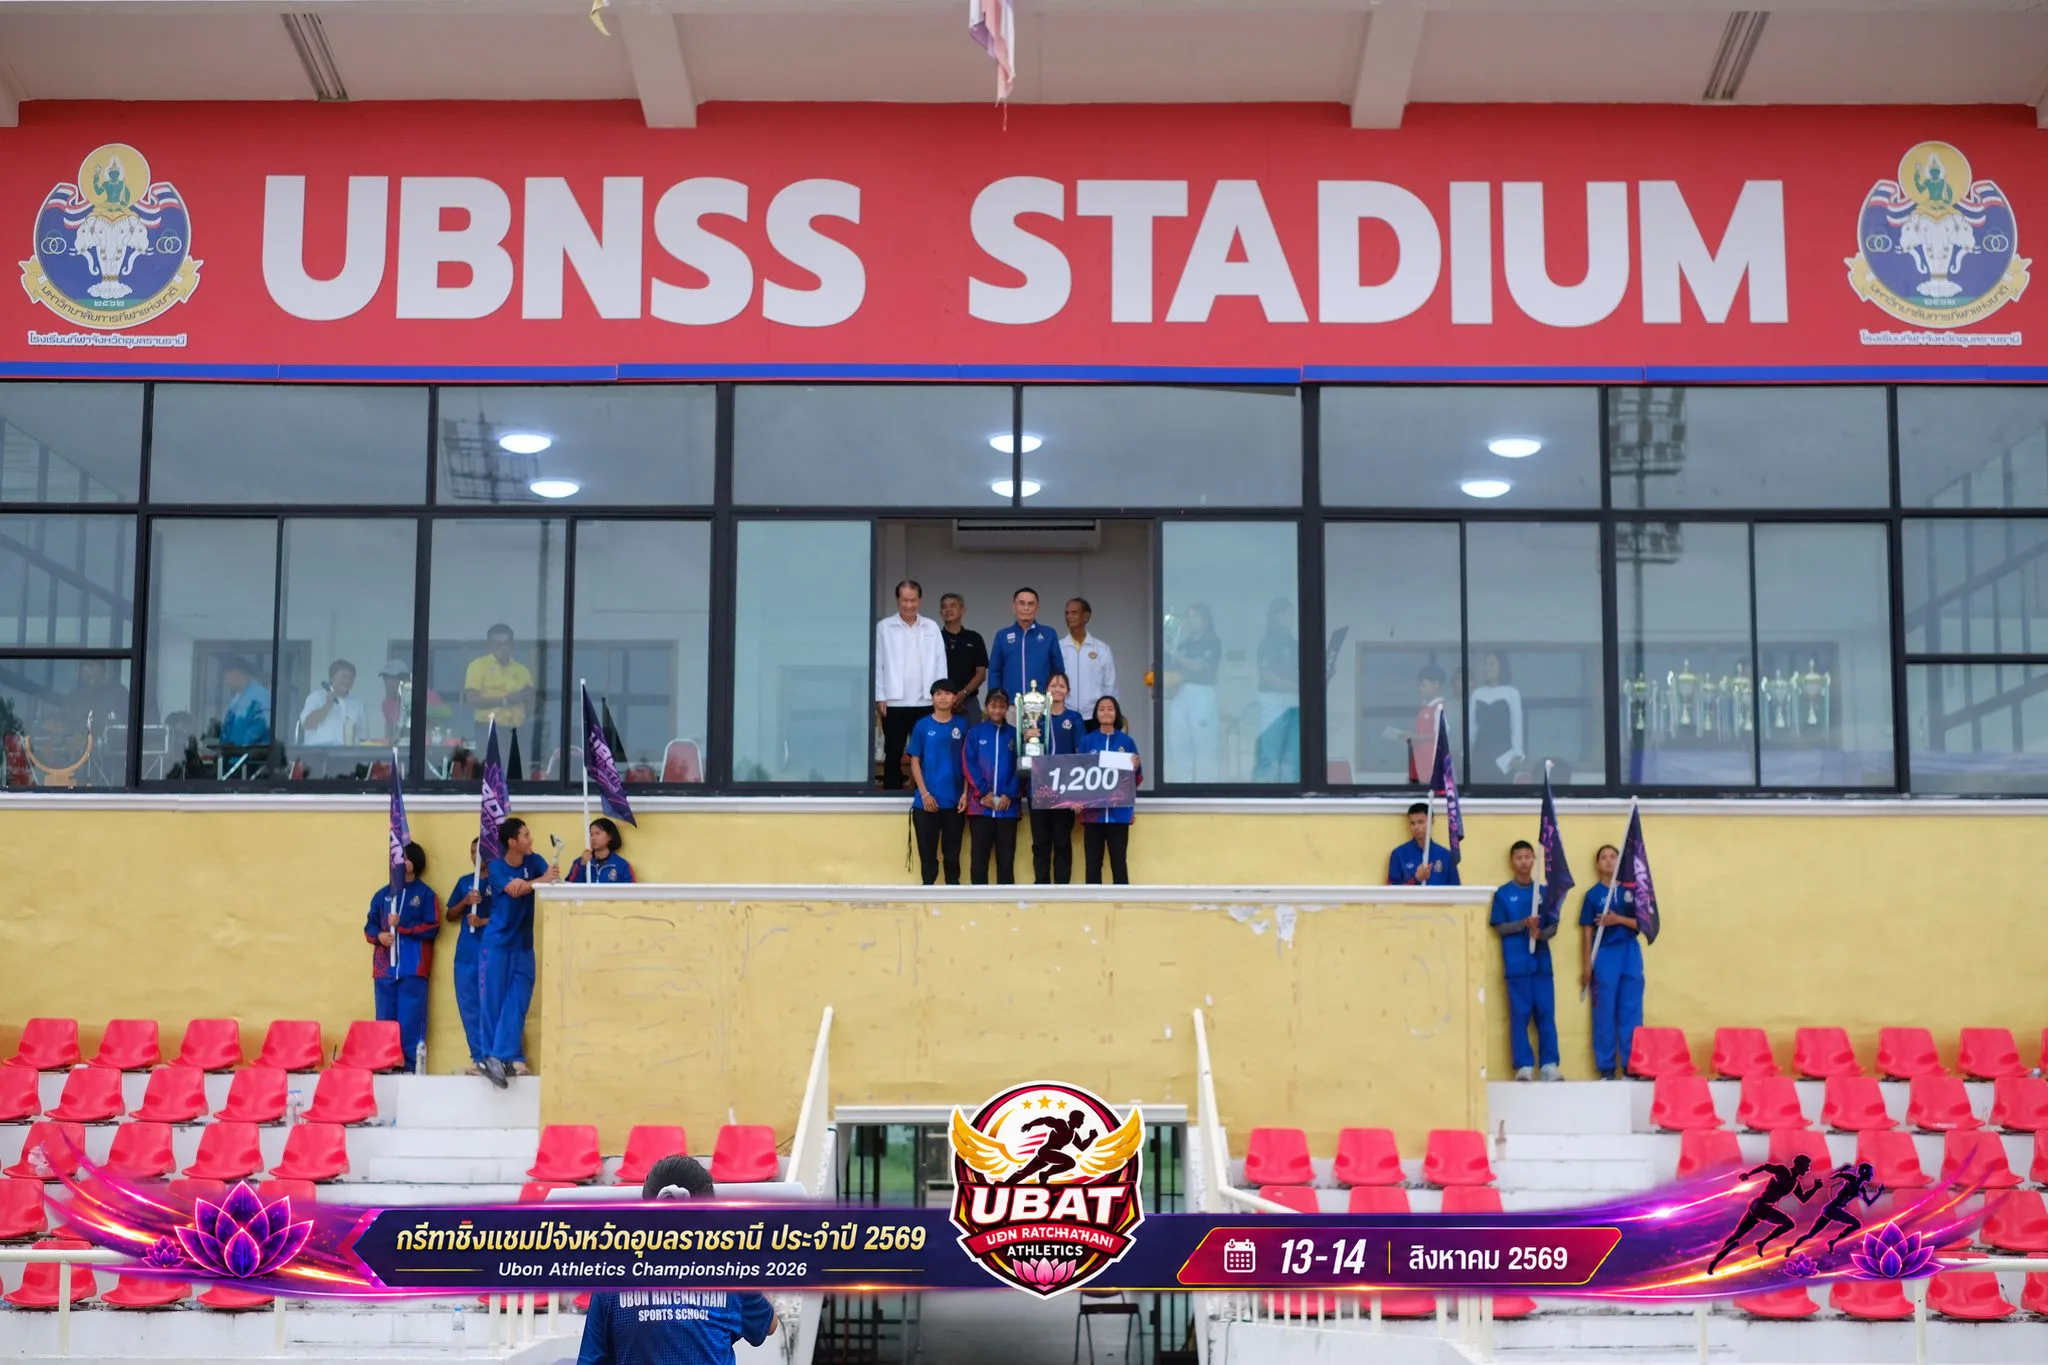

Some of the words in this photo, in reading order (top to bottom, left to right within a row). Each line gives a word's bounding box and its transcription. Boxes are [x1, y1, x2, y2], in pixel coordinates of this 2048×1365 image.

[262, 175, 866, 328] UBNSS
[968, 175, 1789, 328] STADIUM
[1048, 766, 1120, 794] 1,200
[619, 1290, 649, 1308] UBON
[651, 1290, 727, 1308] RATCHATHANI
[638, 1308, 674, 1322] SPORTS
[675, 1307, 710, 1321] SCHOOL
